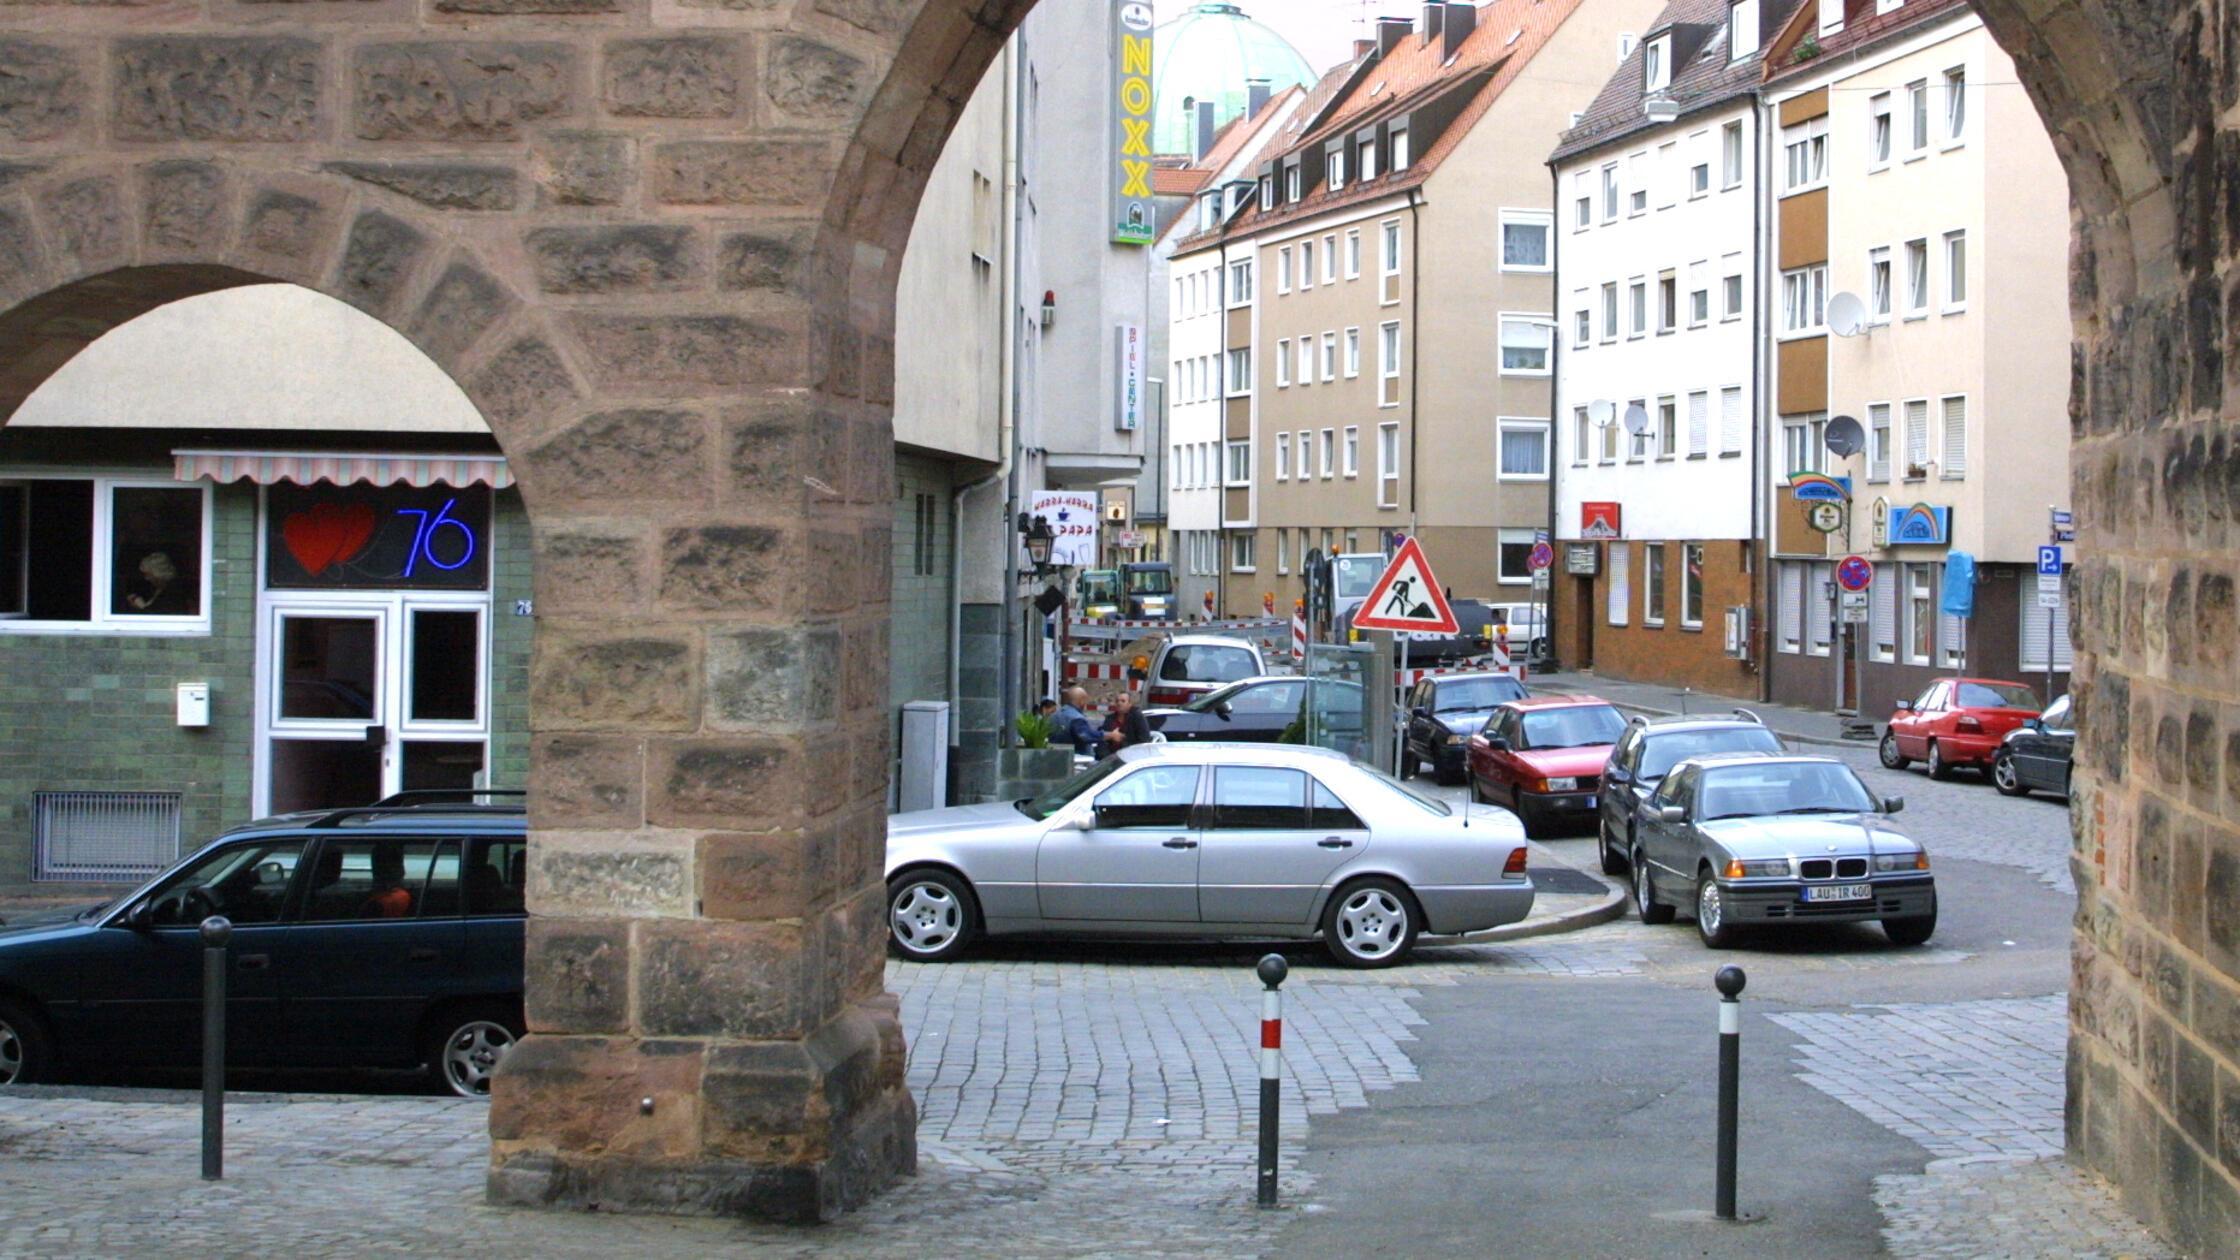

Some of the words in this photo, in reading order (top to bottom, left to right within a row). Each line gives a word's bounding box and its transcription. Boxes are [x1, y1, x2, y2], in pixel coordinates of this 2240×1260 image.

[1121, 34, 1152, 198] NOXX
[397, 498, 474, 577] 76
[2041, 549, 2055, 572] P
[1809, 886, 1831, 899] LAU
